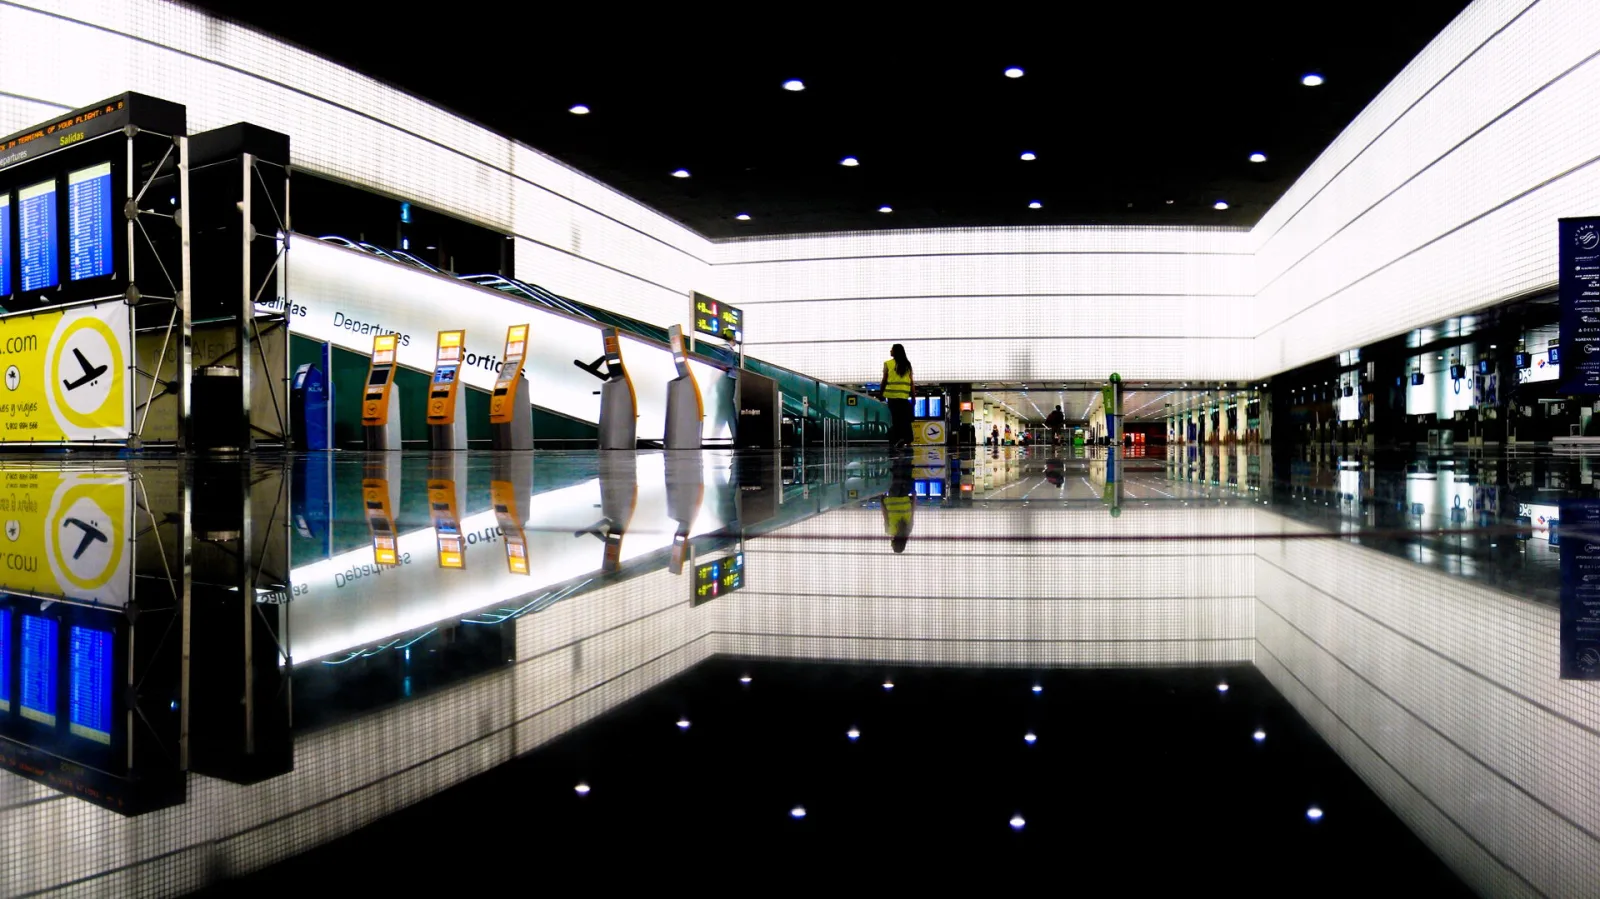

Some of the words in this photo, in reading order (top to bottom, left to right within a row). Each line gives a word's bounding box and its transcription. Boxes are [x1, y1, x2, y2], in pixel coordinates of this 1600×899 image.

[18, 130, 45, 144] TERMINAL
[47, 125, 56, 134] OF
[58, 119, 73, 130] YOUR
[60, 131, 84, 146] Salidas
[0, 334, 37, 355] .com
[460, 347, 526, 378] ortis
[17, 402, 38, 417] viajes
